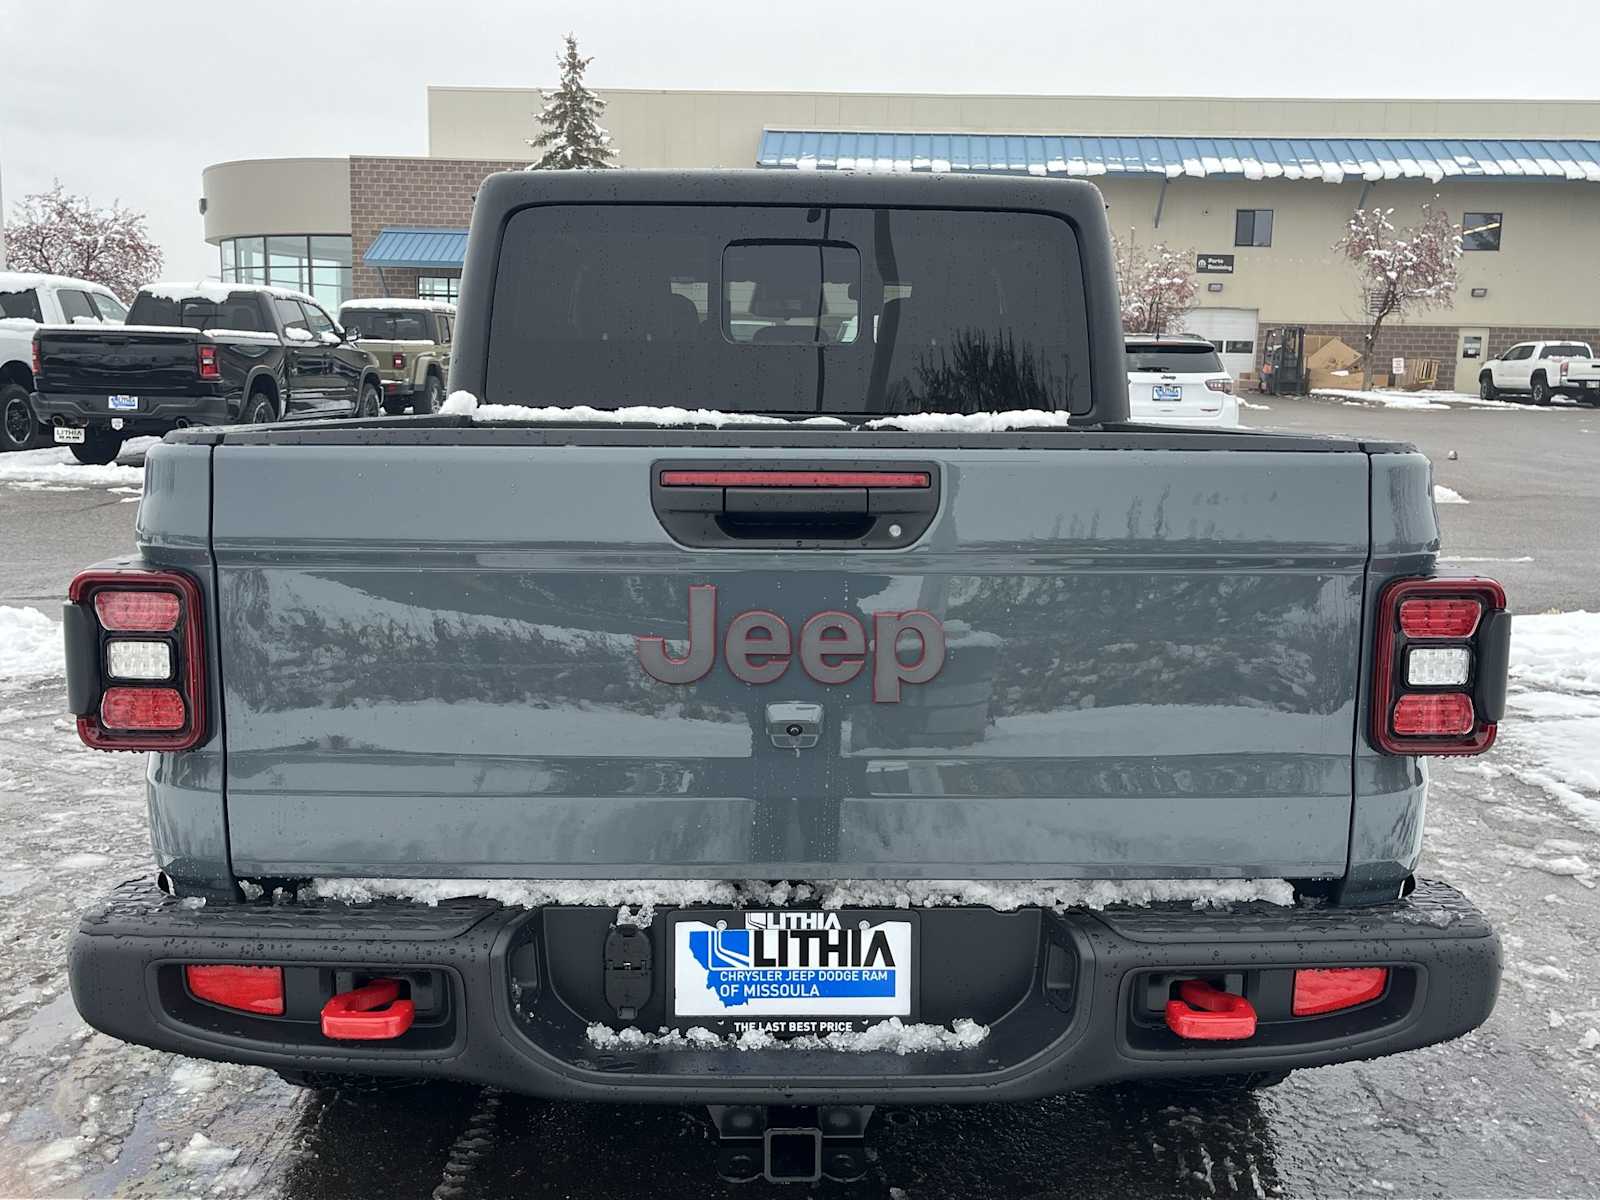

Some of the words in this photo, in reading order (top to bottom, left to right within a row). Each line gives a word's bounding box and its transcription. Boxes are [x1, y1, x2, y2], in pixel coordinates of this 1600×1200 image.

[639, 584, 945, 703] Jeep
[767, 912, 842, 929] LITHIA
[754, 930, 896, 967] LITHIA
[720, 971, 783, 981] CHRYSLER
[786, 971, 815, 981] JEEP
[818, 971, 859, 981] DODGE
[862, 971, 888, 981] RAM
[720, 984, 739, 997] OF
[743, 984, 820, 997] MISSOULA
[734, 1022, 757, 1032] THE
[759, 1022, 786, 1032] LAST
[789, 1022, 818, 1032] BEST
[821, 1022, 853, 1032] PRICE
